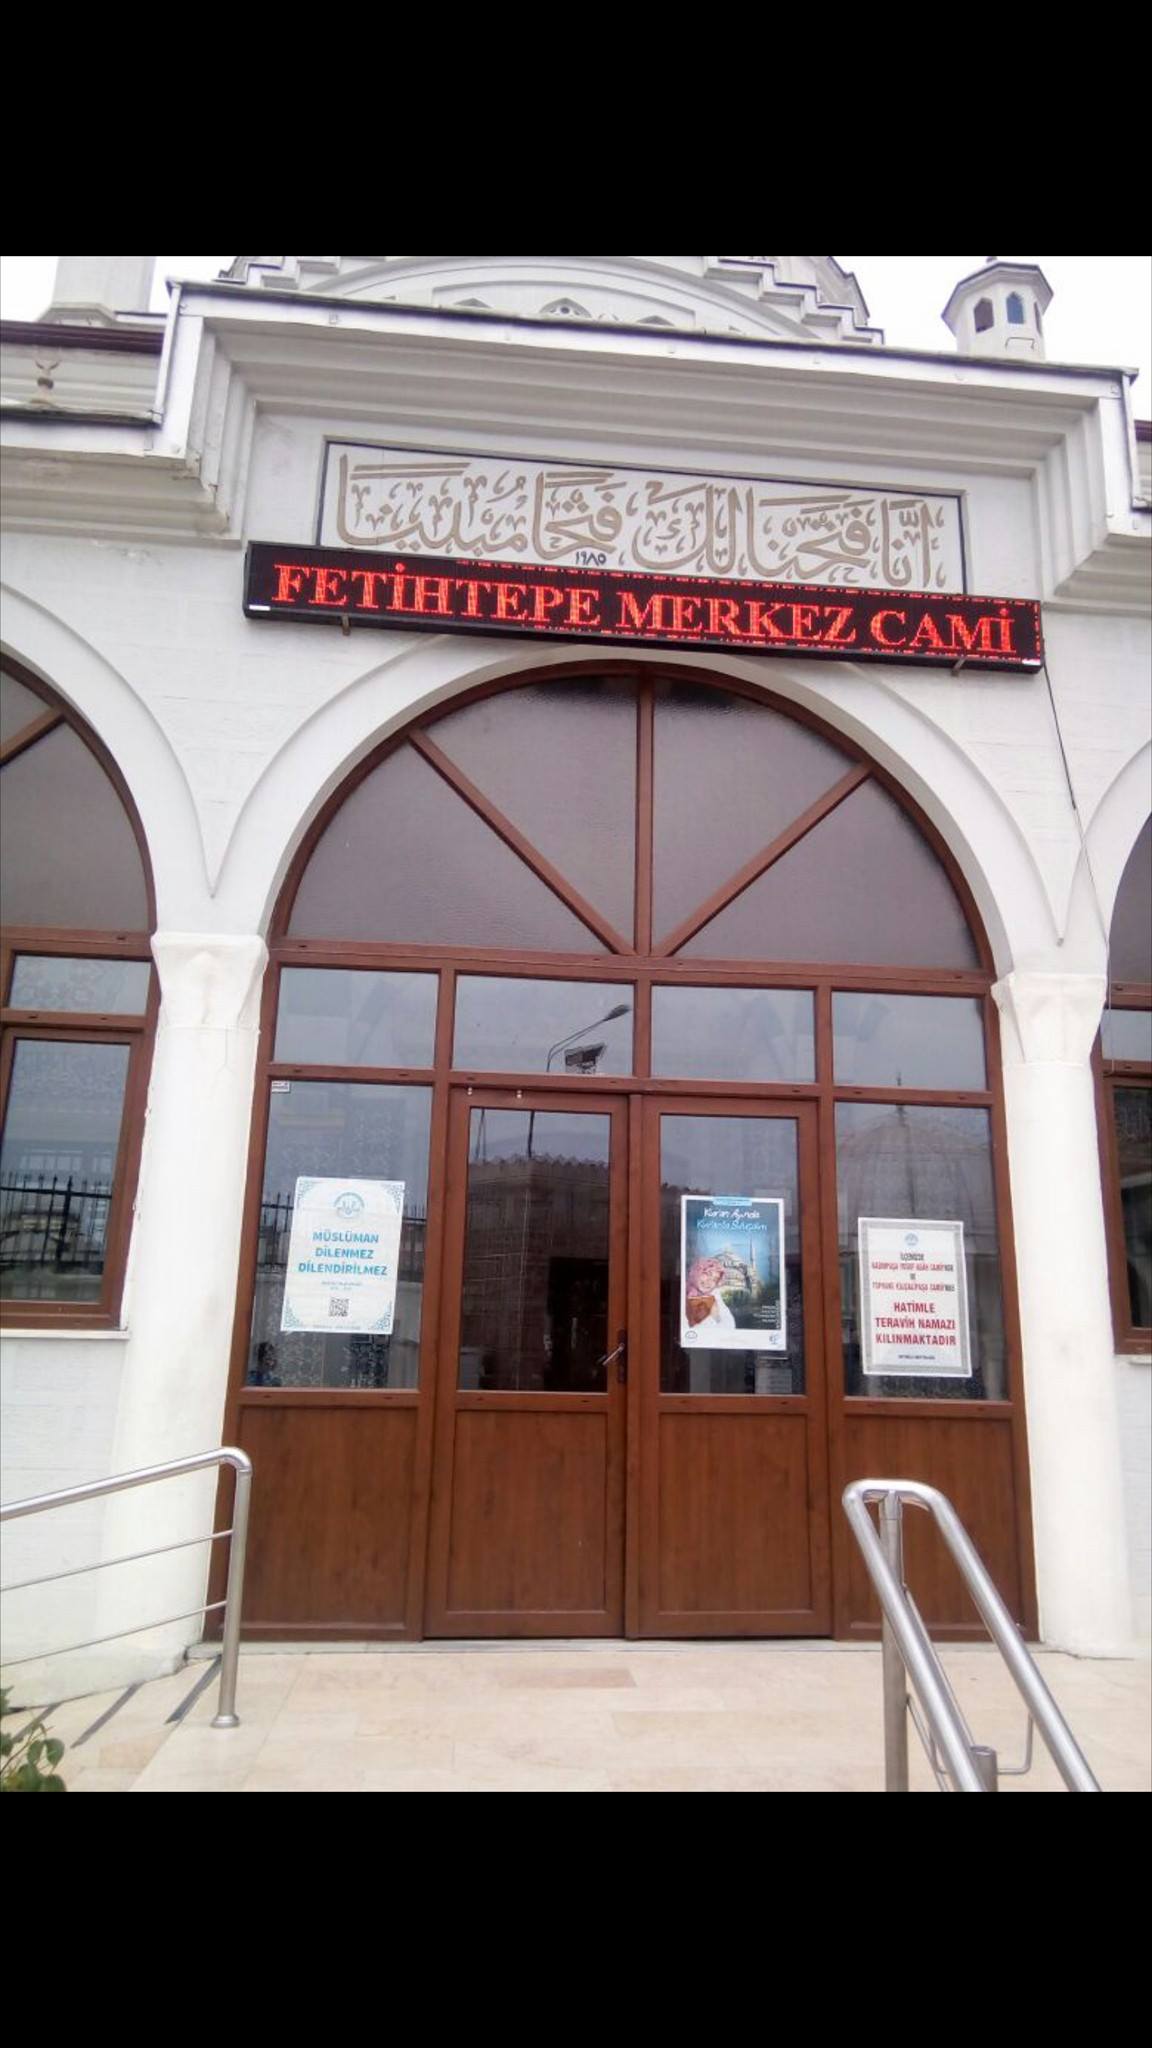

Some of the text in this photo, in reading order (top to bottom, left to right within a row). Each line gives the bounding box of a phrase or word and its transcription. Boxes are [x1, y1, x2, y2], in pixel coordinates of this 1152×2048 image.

[272, 562, 1017, 653] FETİHTEPE MERKEZ CAMİ
[312, 1229, 380, 1244] MÜSLÜMAN
[314, 1246, 374, 1260] DİLENMEZ
[298, 1261, 388, 1276] DİLENDİRİLMEZ
[893, 1300, 936, 1313] HATİMLE
[875, 1315, 956, 1330] TERAVİH NAMAZI
[875, 1334, 957, 1346] KILINMAKTADIR
